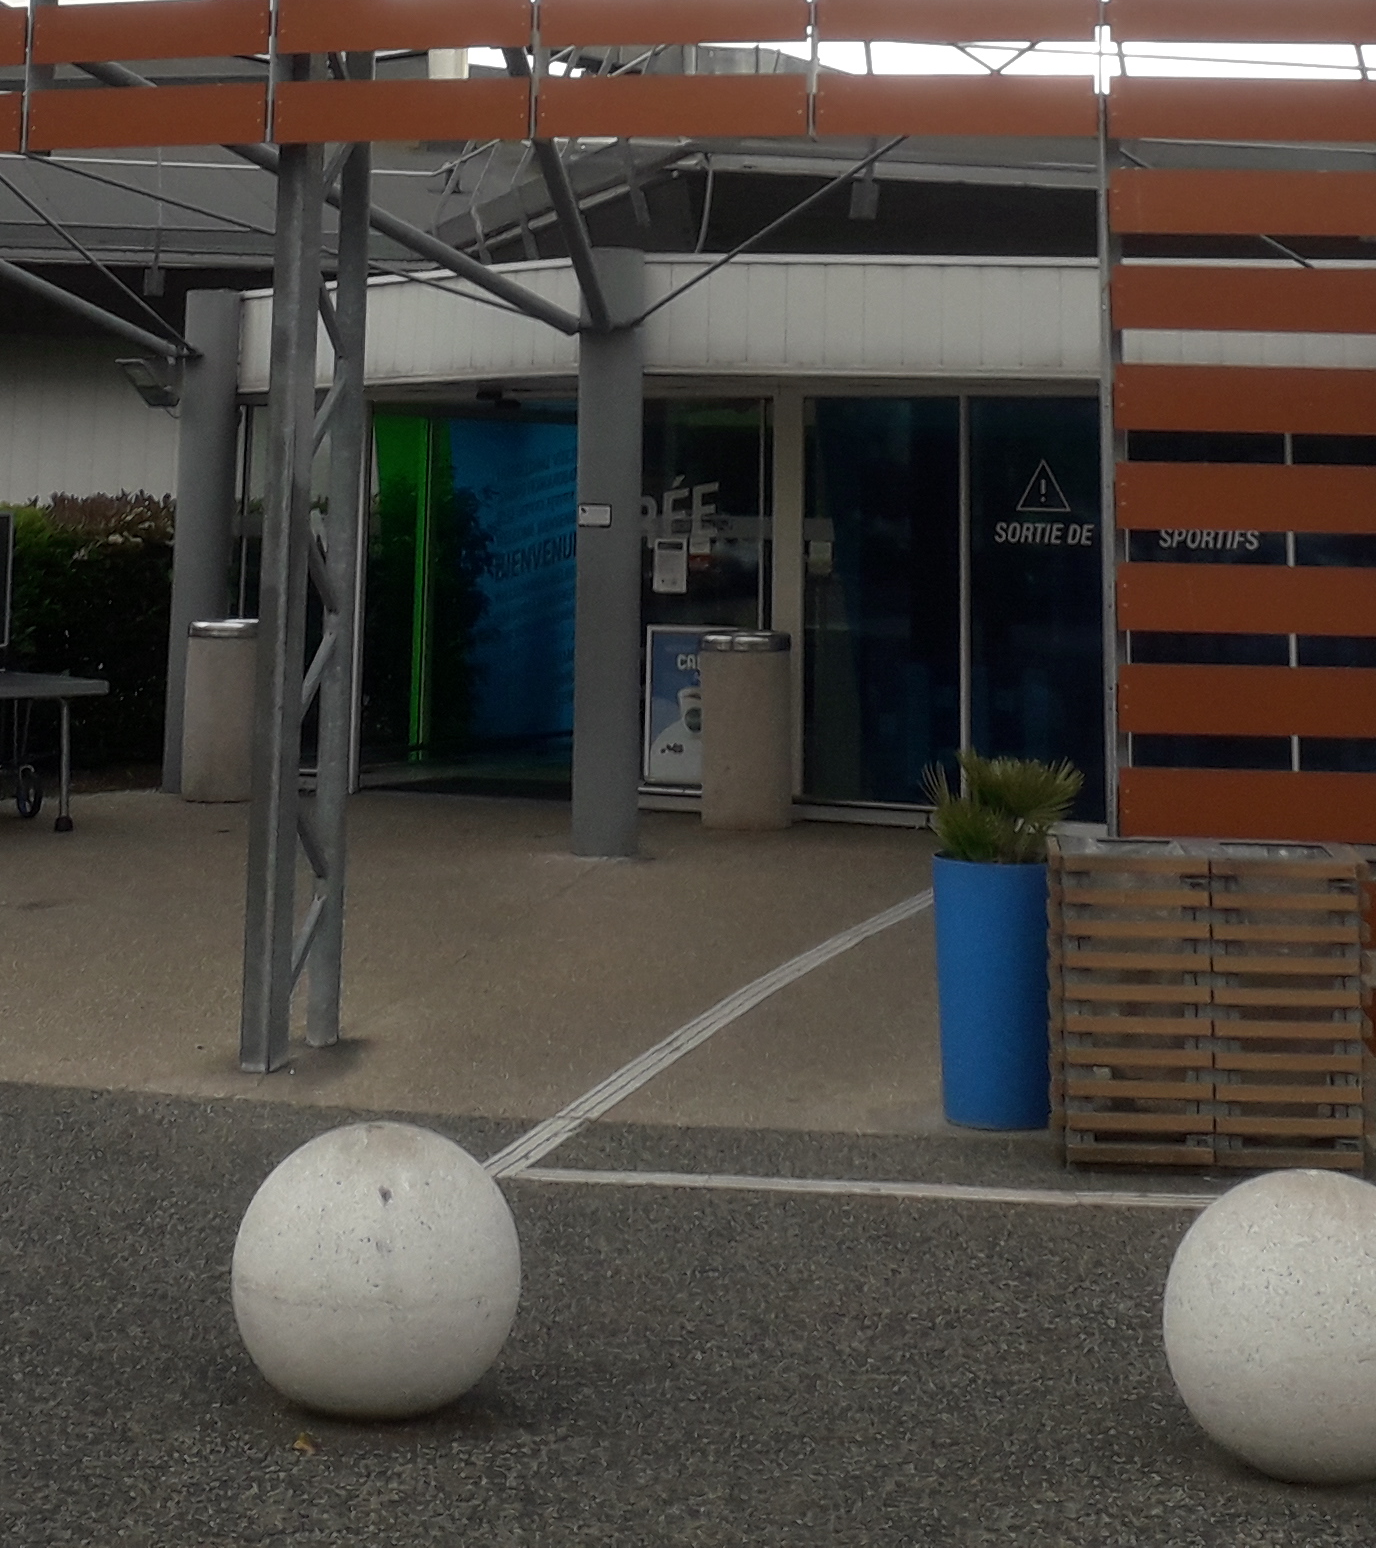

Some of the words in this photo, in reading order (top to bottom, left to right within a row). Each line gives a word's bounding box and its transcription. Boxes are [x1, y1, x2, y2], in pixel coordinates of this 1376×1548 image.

[641, 474, 720, 549] RÉE
[993, 521, 1065, 545] SORTIE
[1066, 523, 1095, 546] DE
[1158, 529, 1260, 551] SPORTIFS
[495, 532, 577, 583] BIENVENU
